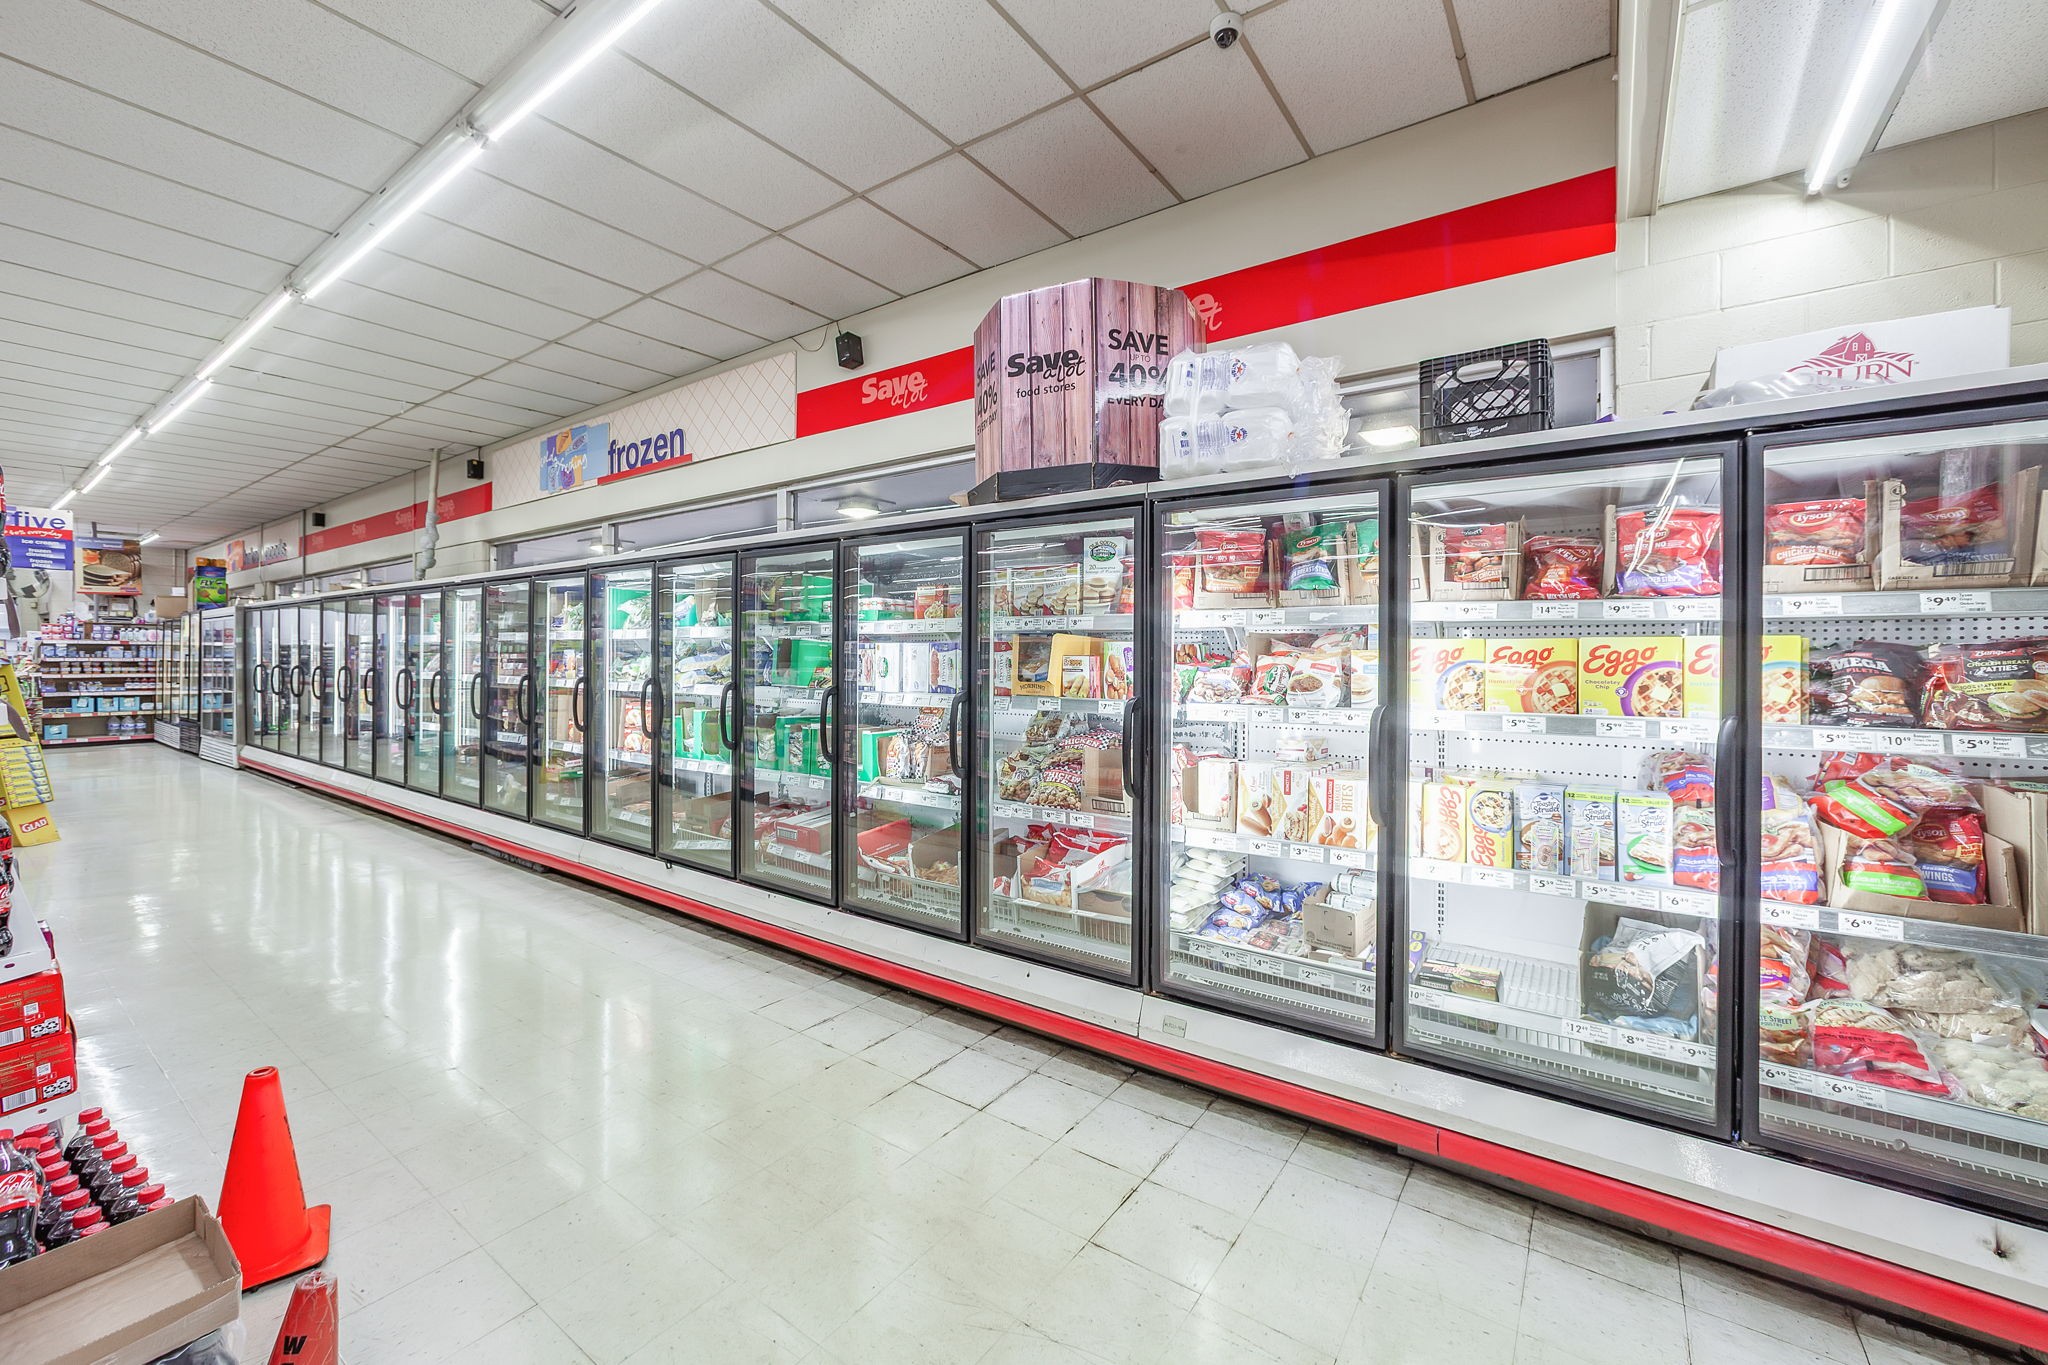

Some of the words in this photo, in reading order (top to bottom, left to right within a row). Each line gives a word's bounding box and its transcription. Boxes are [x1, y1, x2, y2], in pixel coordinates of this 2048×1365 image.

[1108, 329, 1169, 355] SAVE
[977, 351, 996, 387] SAVE
[1007, 349, 1080, 378] Save
[862, 370, 926, 404] Save
[1016, 386, 1041, 399] food
[1043, 382, 1076, 395] stores
[977, 381, 998, 418] 40%
[1149, 397, 1166, 408] DA
[989, 409, 998, 425] DAY
[608, 428, 685, 474] frozen
[12, 511, 66, 530] five
[1797, 511, 1833, 524] Tyson
[1926, 508, 1966, 521] Tyson
[1583, 644, 1659, 677] Eggo
[1830, 656, 1893, 673] MEGA
[21, 818, 48, 834] GLAD
[1917, 829, 1947, 839] Tyson
[1922, 870, 1955, 882] WINGS
[1770, 1016, 1793, 1025] STREET
[283, 1335, 308, 1355] W
